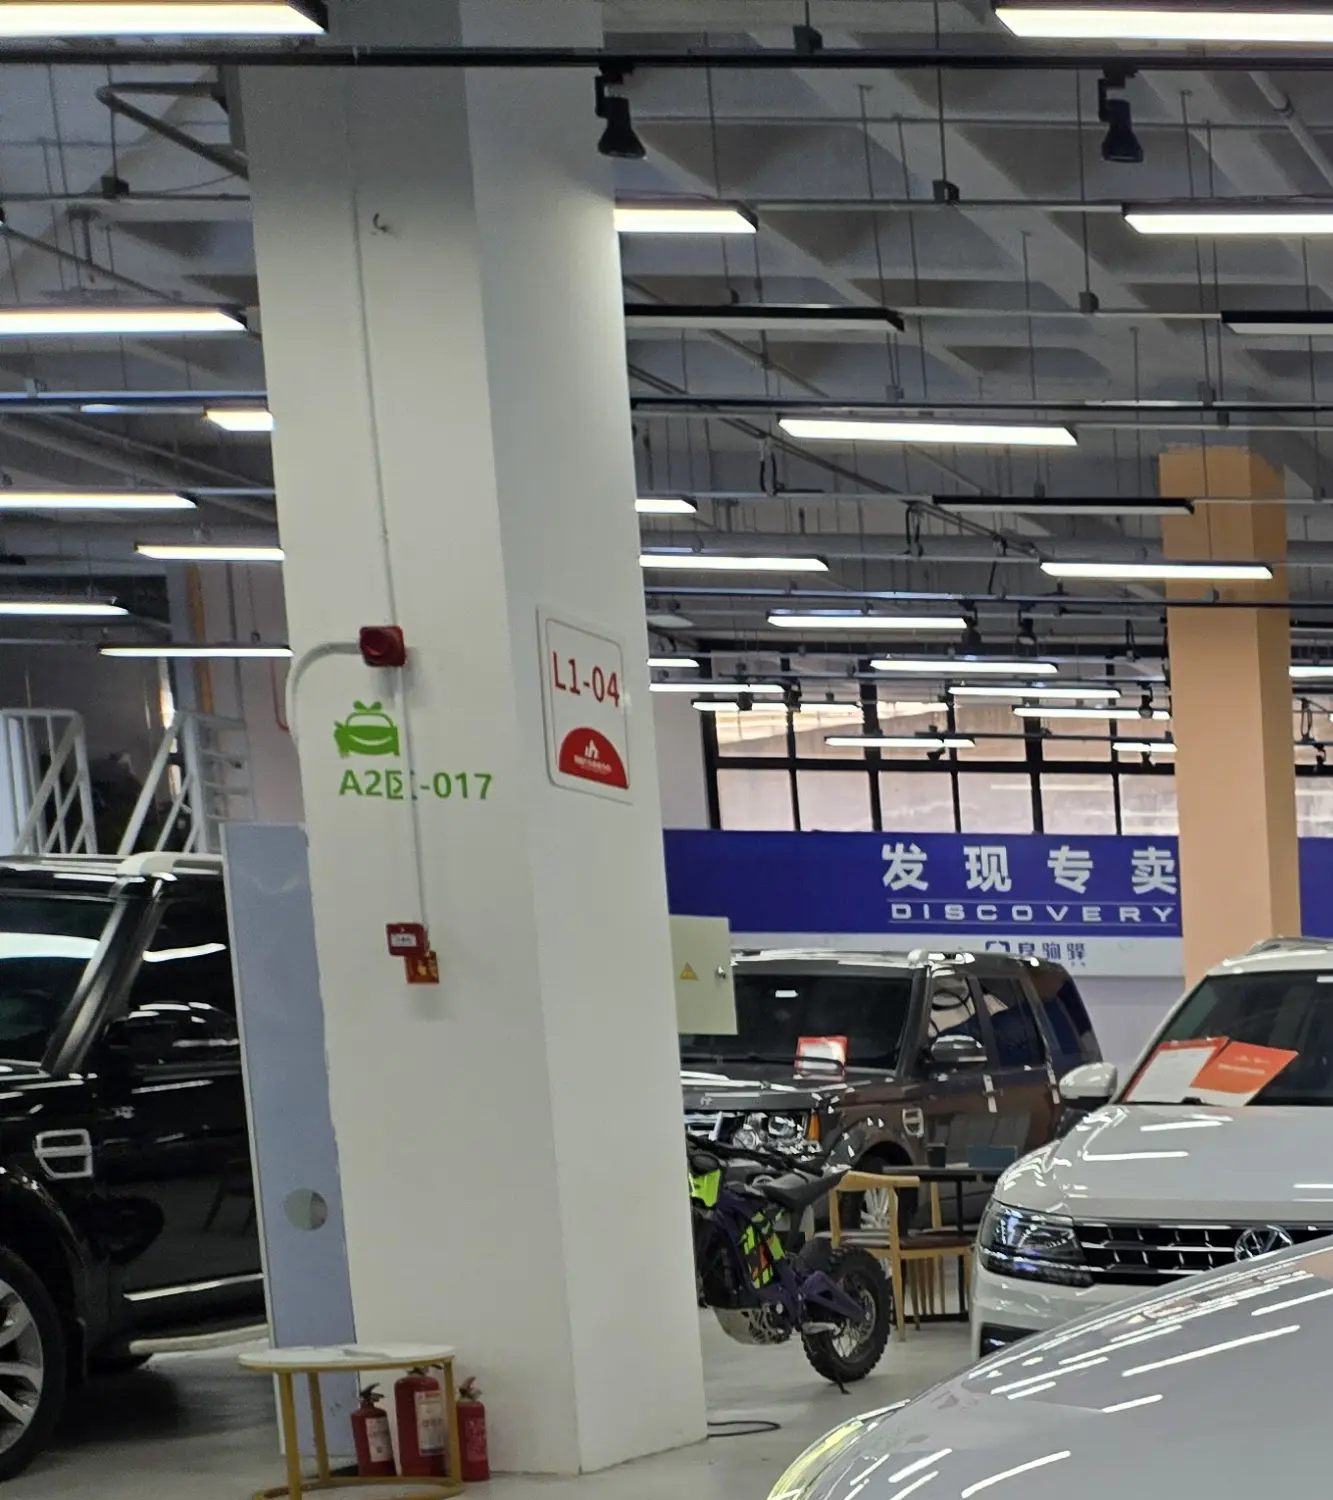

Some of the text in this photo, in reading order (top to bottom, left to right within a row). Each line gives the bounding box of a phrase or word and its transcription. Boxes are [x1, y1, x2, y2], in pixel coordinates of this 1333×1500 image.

[553, 651, 620, 707] L1-04
[882, 843, 1177, 895] 发现专卖
[891, 903, 1175, 922] DISCOVERY
